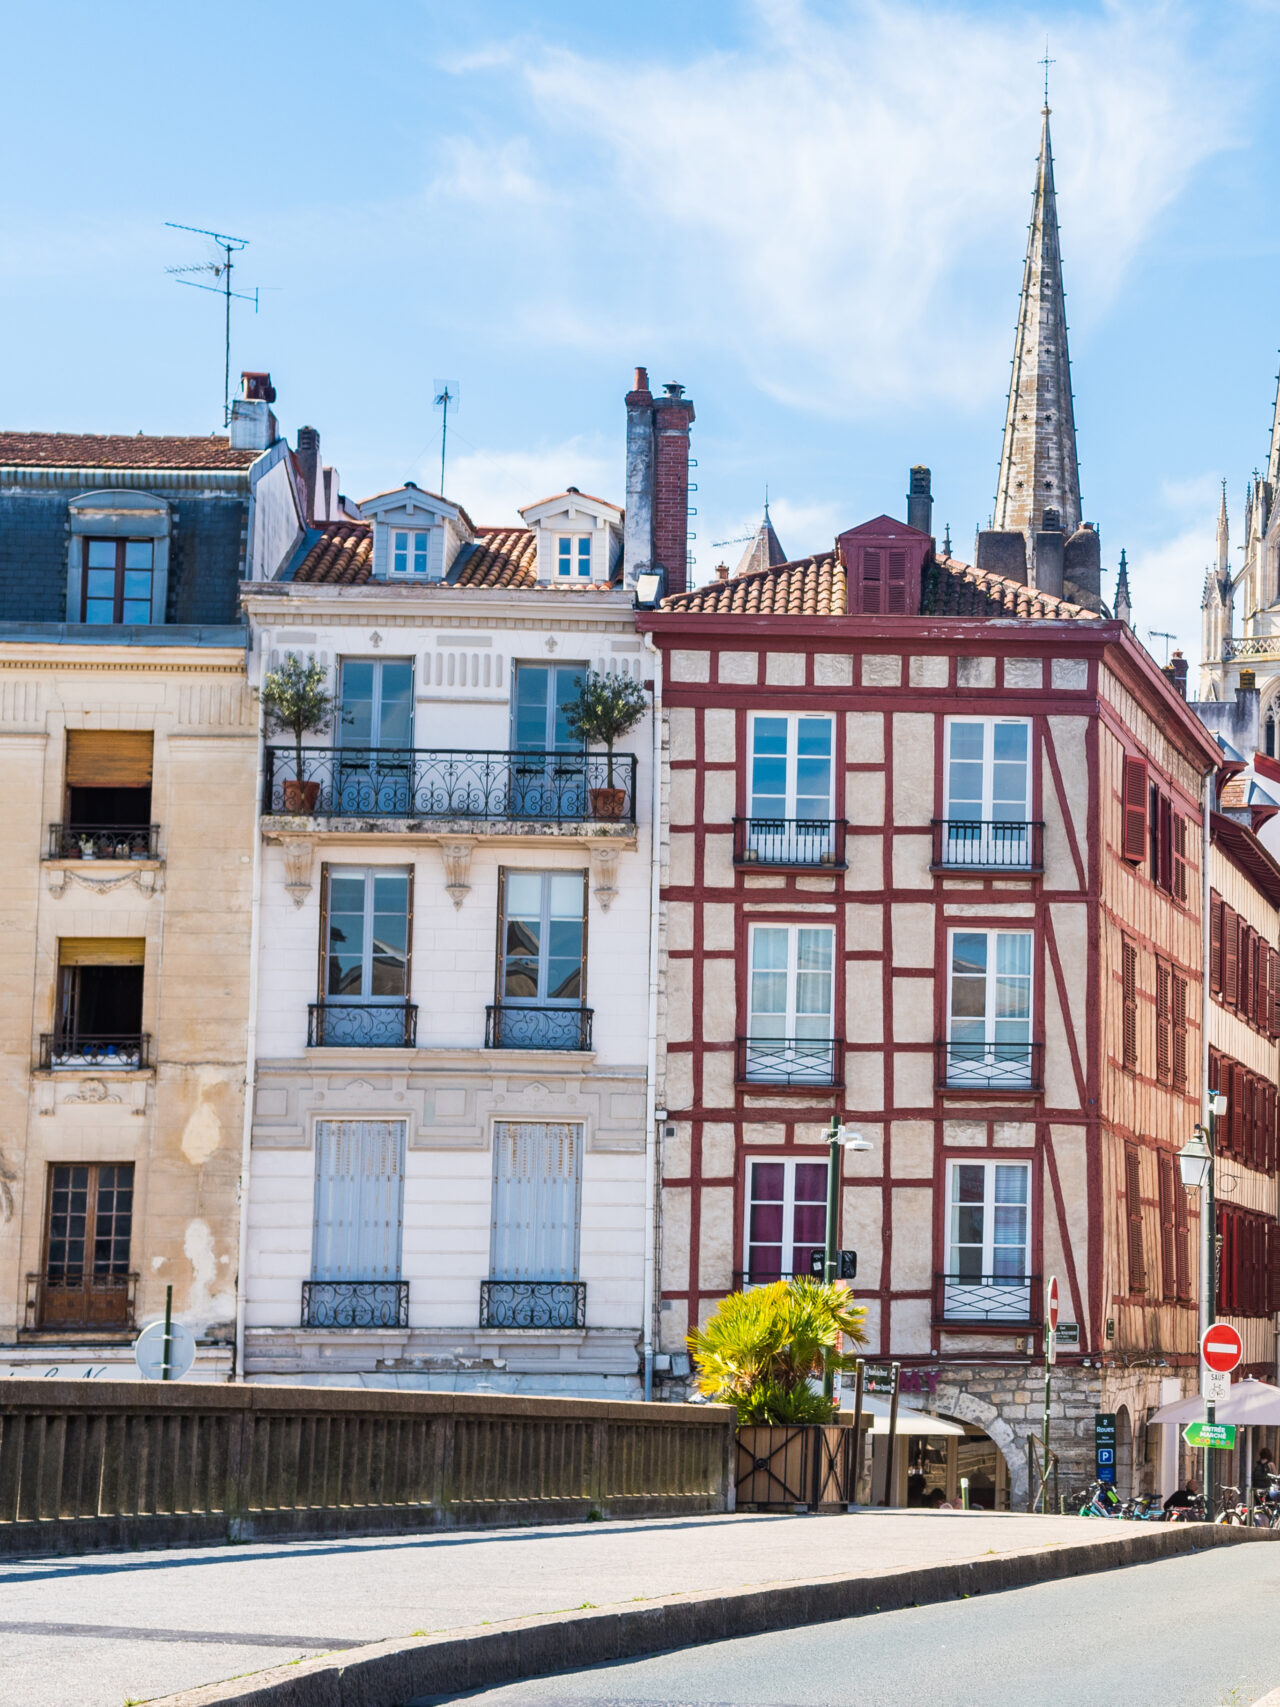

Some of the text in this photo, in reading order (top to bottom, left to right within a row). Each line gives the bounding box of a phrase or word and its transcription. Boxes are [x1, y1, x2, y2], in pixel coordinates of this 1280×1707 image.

[1202, 1425, 1226, 1433] ENTRÉE
[1200, 1431, 1226, 1439] MARCHÉ
[1102, 1452, 1109, 1461] P
